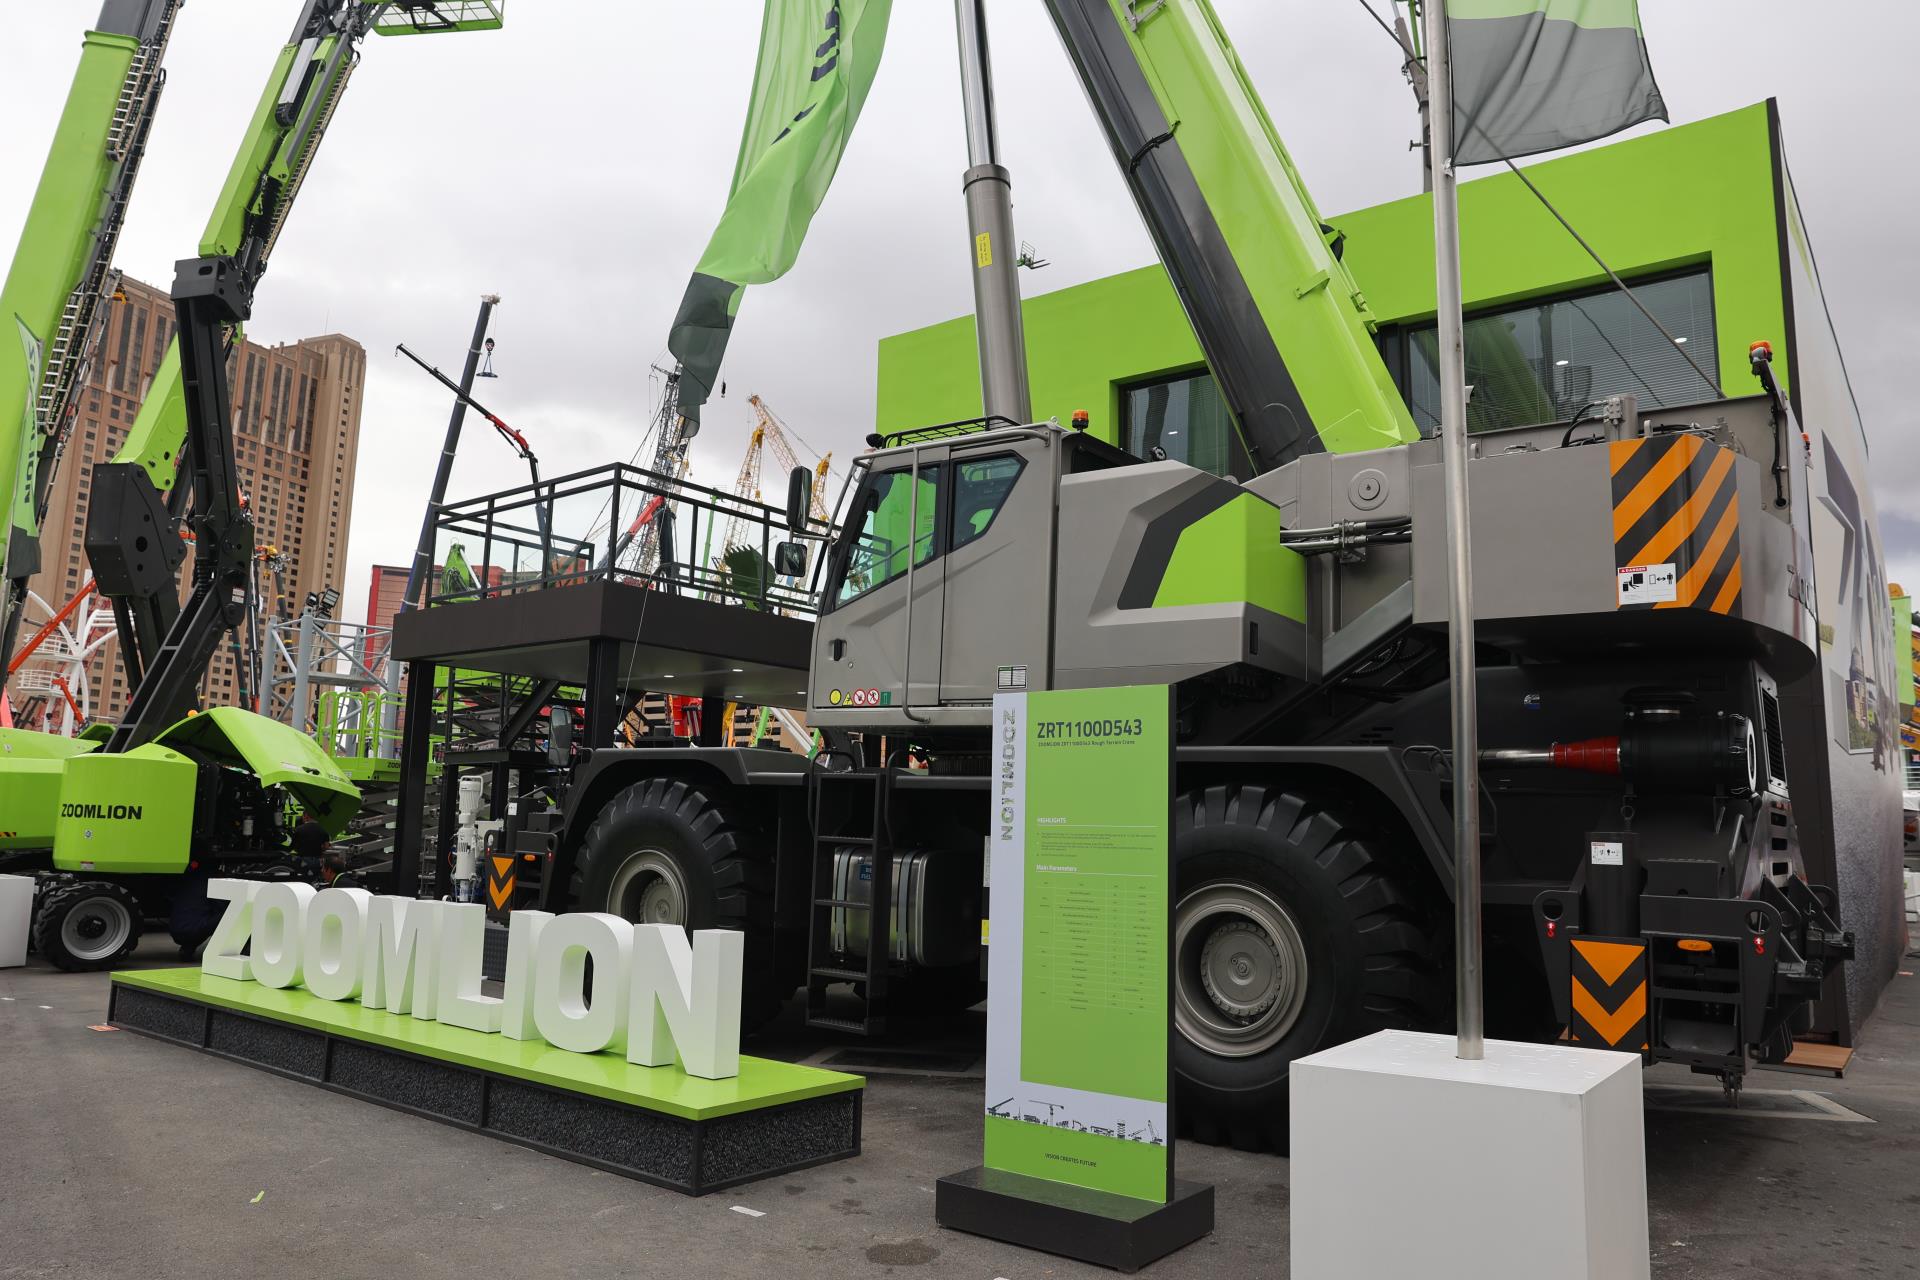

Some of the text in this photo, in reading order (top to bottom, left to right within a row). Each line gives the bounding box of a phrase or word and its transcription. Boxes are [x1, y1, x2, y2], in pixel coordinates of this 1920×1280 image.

[1037, 719, 1142, 738] ZRT1100D543
[1001, 708, 1016, 840] ZOOMLION
[61, 803, 143, 820] ZOOMLION
[1037, 816, 1068, 824] HIGHLIGHTS
[201, 877, 746, 1080] ZOOMLION
[1044, 1152, 1097, 1168] VISION CREATES FUTURE
